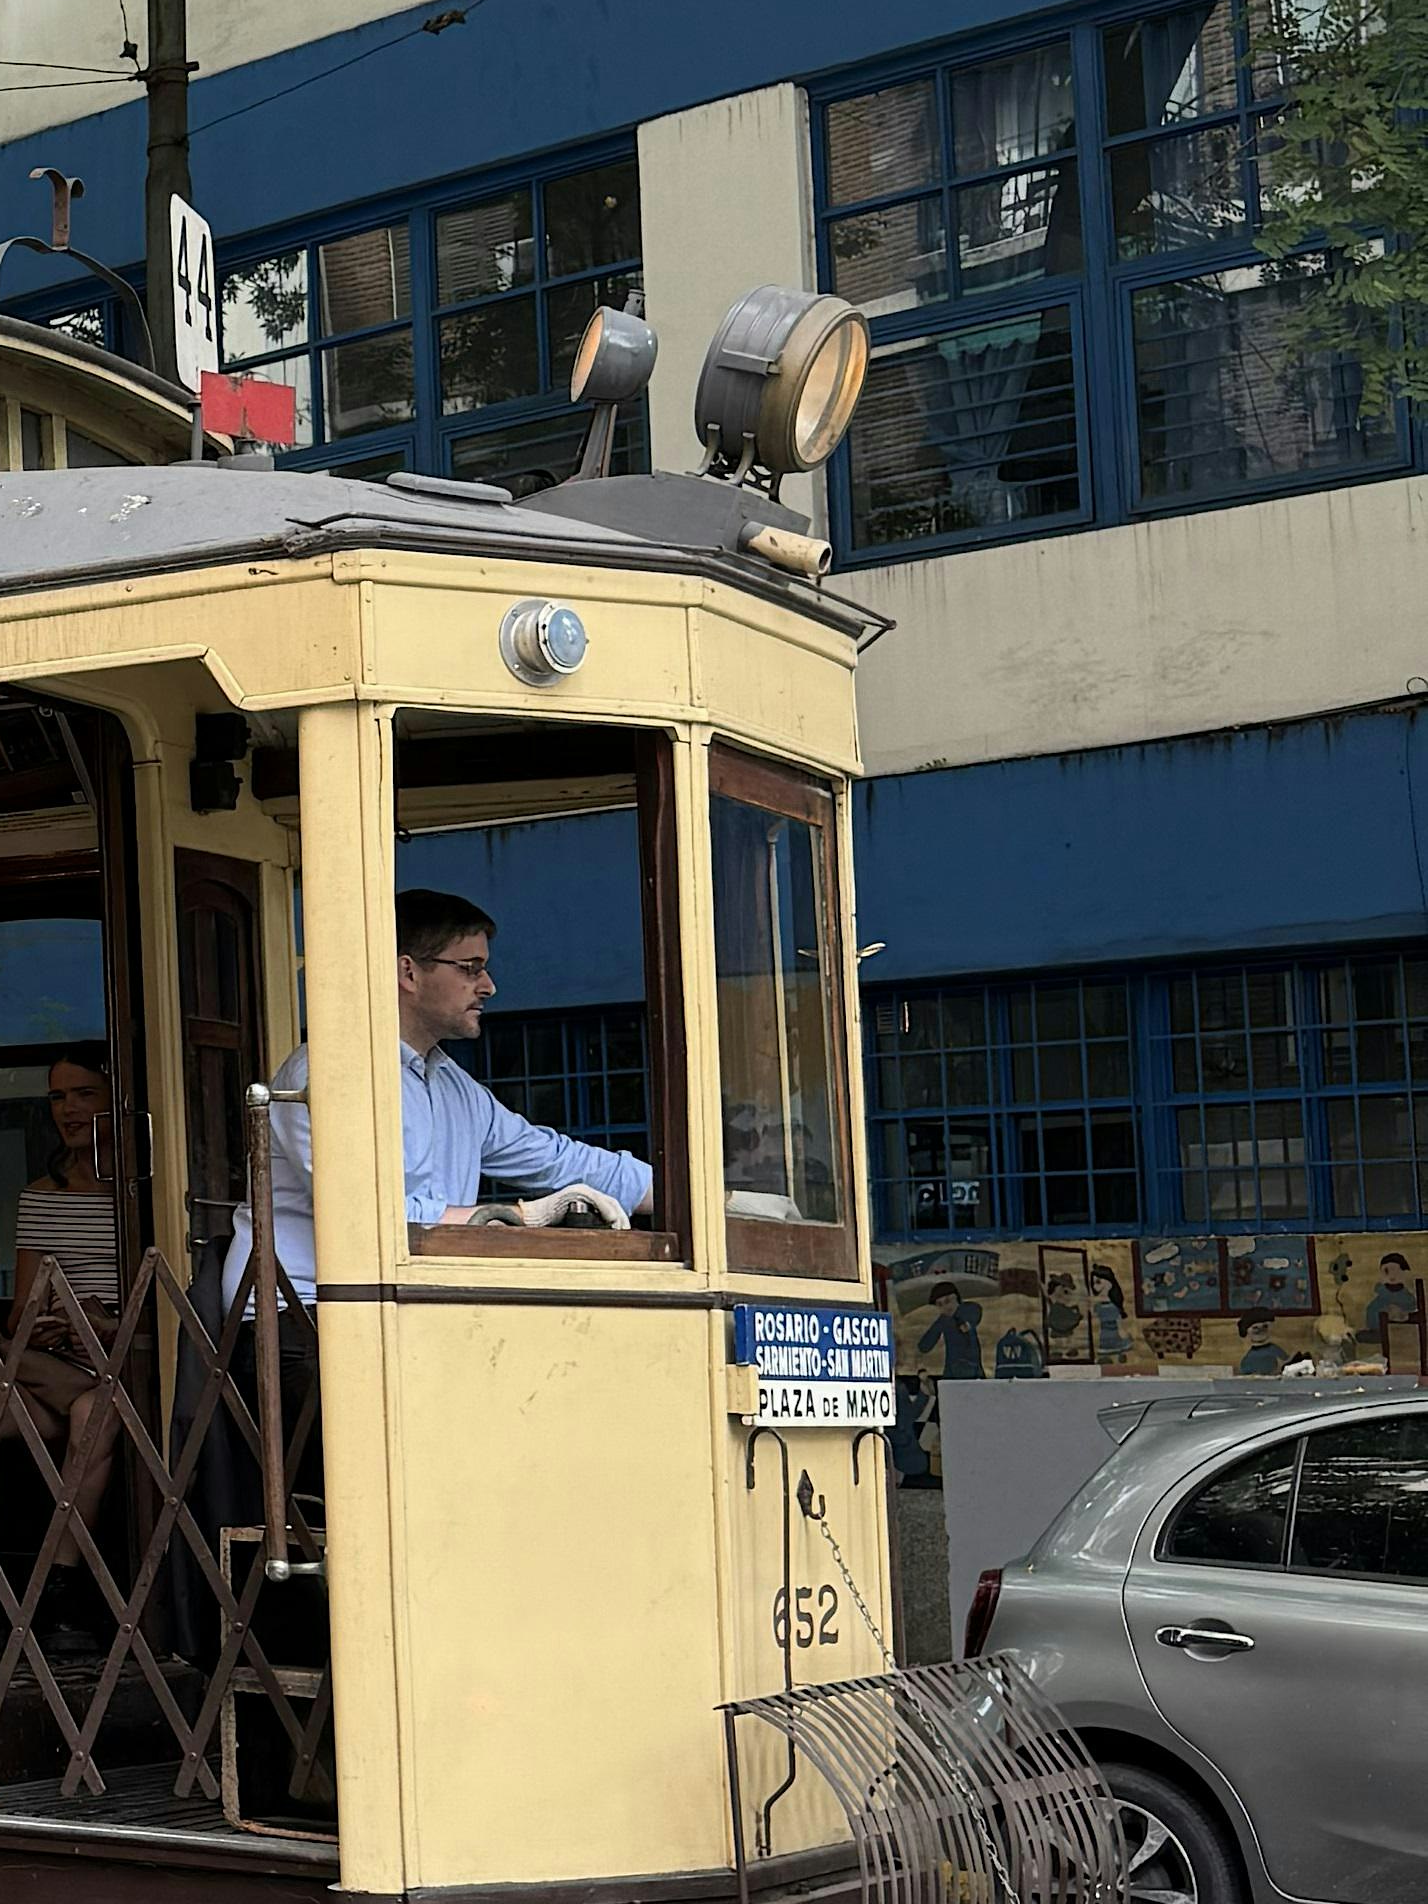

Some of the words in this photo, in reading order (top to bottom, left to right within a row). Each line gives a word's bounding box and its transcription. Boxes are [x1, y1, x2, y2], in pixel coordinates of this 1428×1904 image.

[178, 215, 213, 342] 44
[754, 1311, 820, 1344] ROSARIO
[832, 1314, 889, 1347] GASCON
[851, 1348, 890, 1378] MARTIN
[759, 1387, 817, 1418] PLAZA
[846, 1389, 890, 1418] MAYO
[773, 1583, 839, 1648] 652
